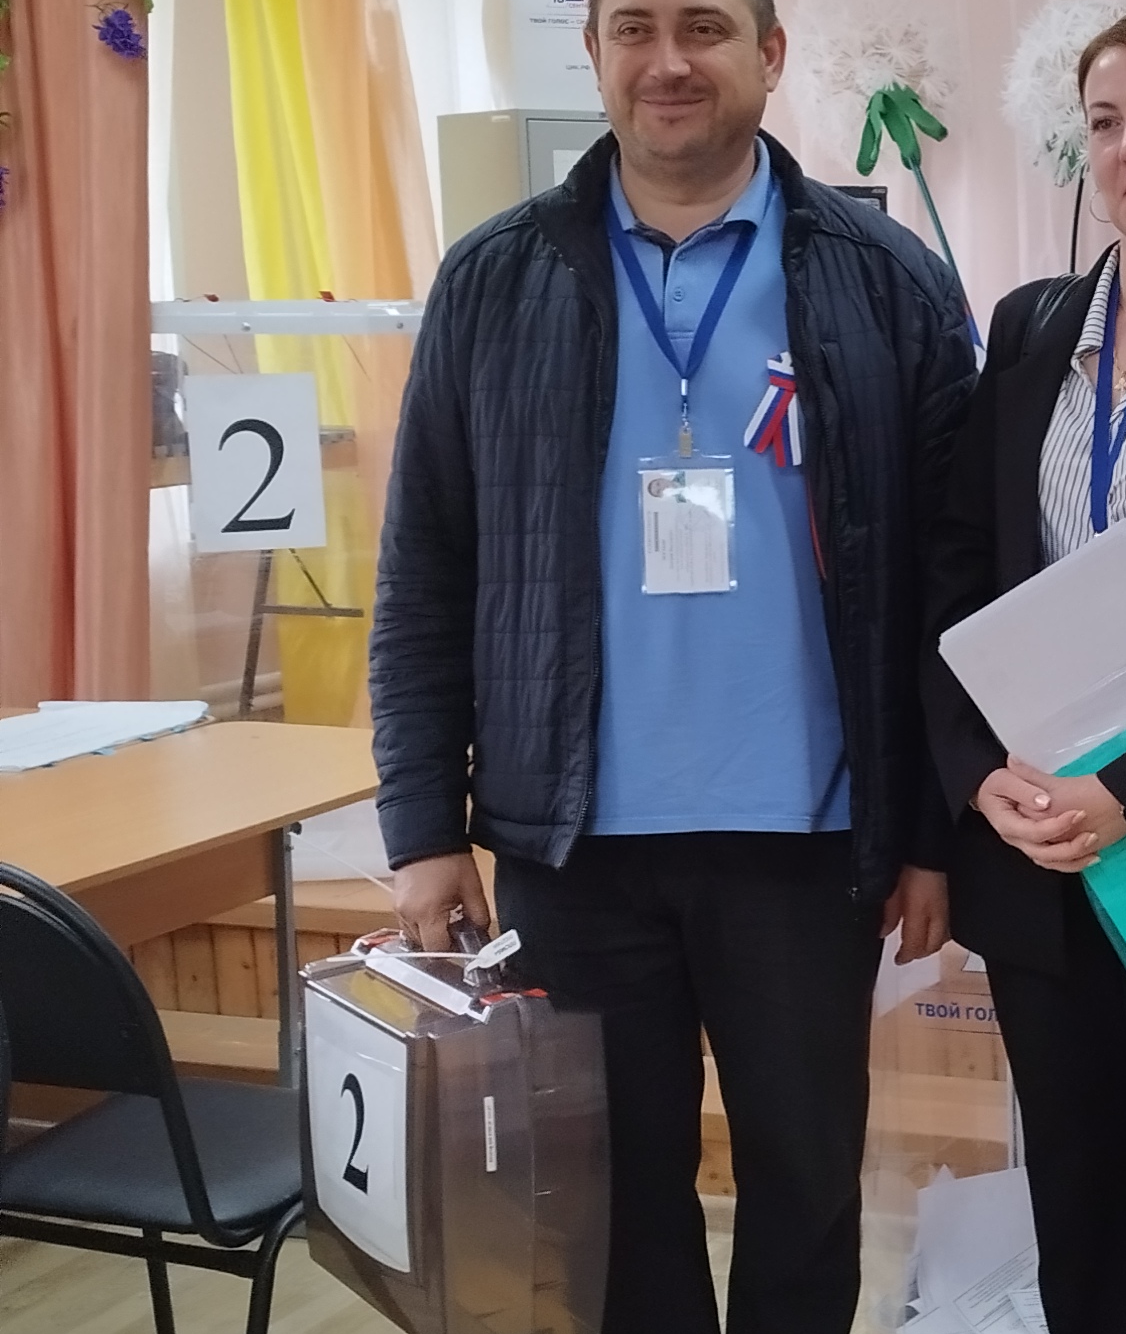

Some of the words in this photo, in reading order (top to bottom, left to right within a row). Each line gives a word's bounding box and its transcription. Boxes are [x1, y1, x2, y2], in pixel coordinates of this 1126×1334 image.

[218, 418, 295, 533] 2
[914, 1002, 960, 1019] ТВОЙ
[340, 1072, 369, 1196] 2
